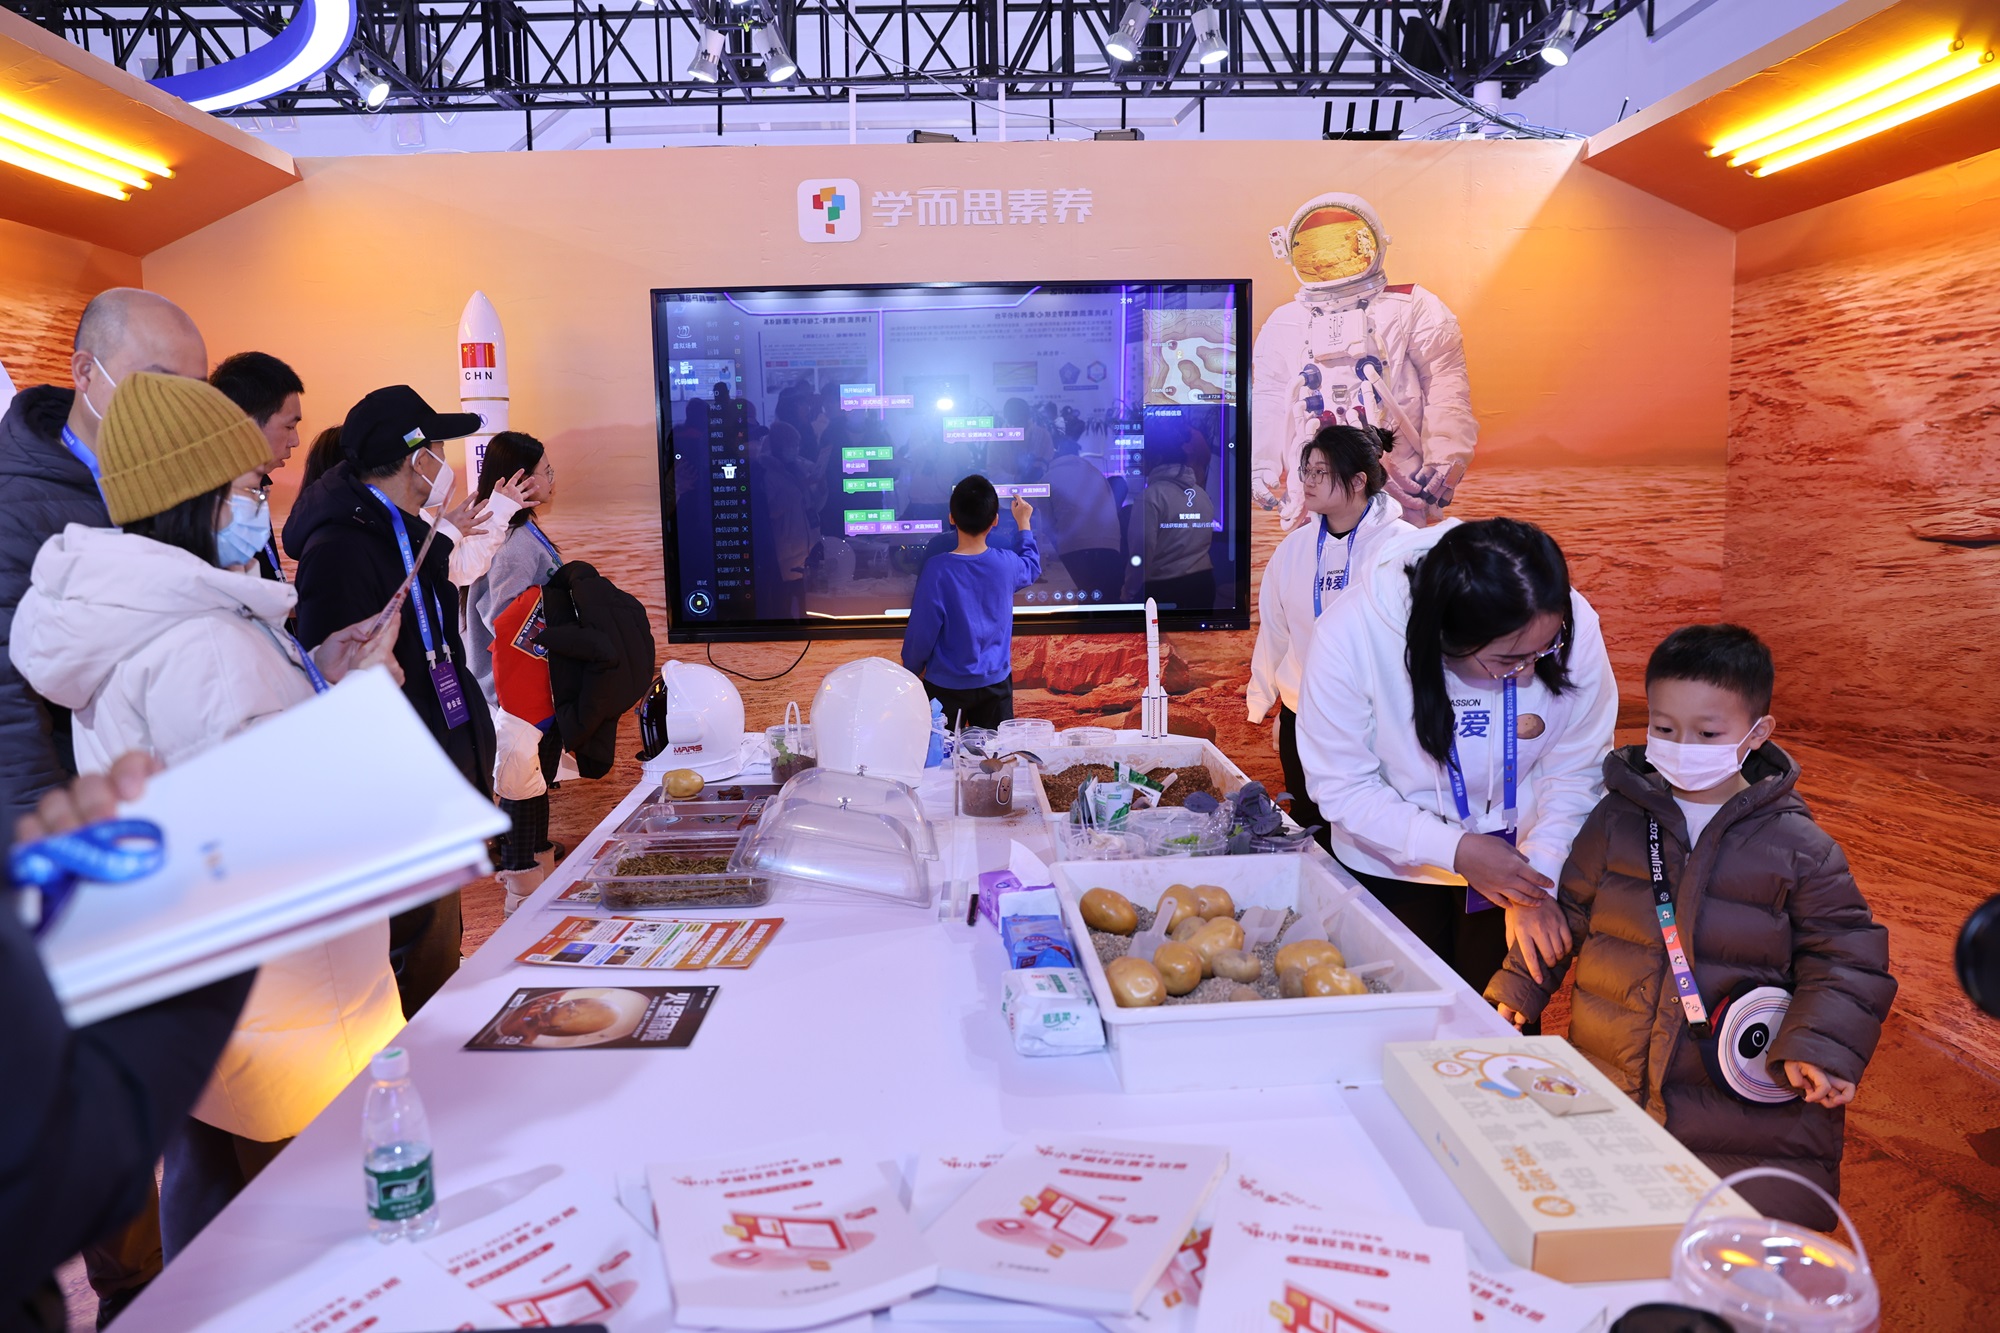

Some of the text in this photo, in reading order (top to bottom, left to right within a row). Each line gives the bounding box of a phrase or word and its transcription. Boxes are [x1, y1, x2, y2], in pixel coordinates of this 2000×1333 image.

[871, 188, 1092, 226] 学而思素养
[465, 371, 492, 380] CHN
[1454, 710, 1490, 738] 爱
[673, 745, 702, 753] MARS
[1652, 843, 1663, 881] BEIJING
[1499, 1157, 1538, 1192] Socks
[1509, 1144, 1560, 1191] Gift Box
